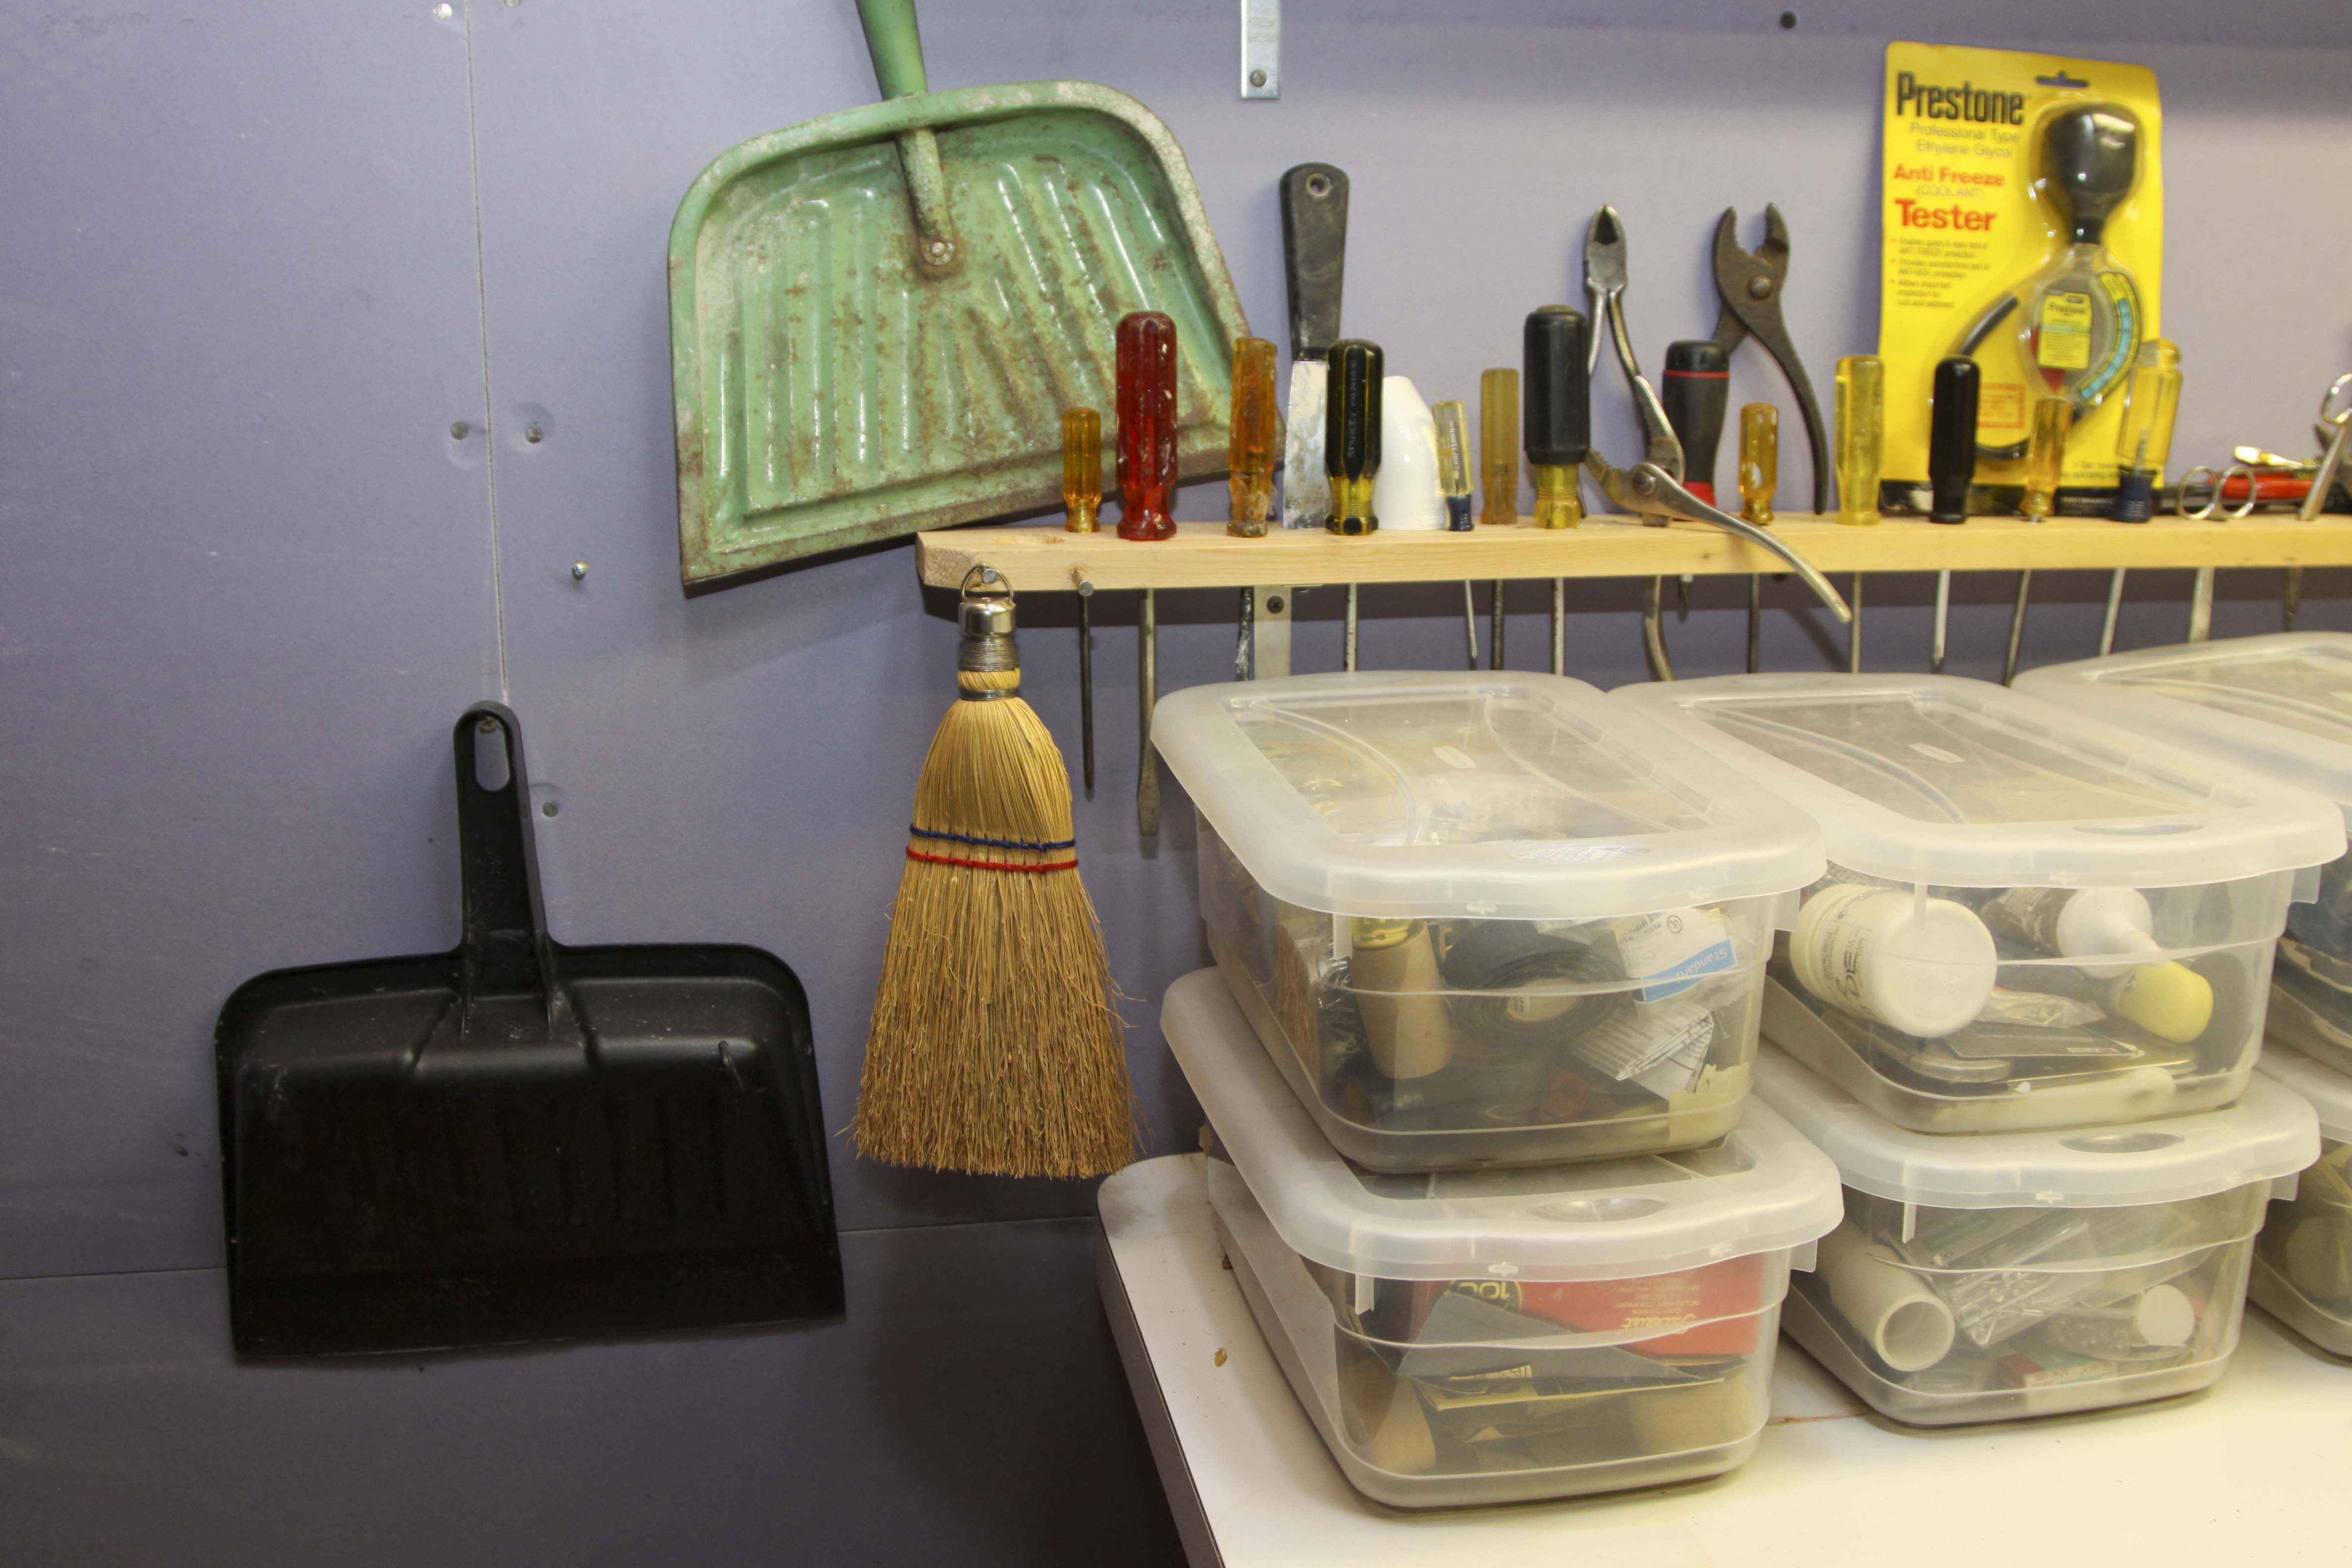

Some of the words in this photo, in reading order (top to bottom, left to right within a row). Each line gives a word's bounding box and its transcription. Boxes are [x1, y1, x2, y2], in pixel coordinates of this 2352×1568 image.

[1896, 71, 2024, 125] Prestone
[1910, 122, 1986, 139] Professional
[1990, 128, 2020, 144] Type
[1917, 139, 1969, 154] Ethylene
[1975, 144, 2012, 158] Glycol
[1894, 164, 1933, 181] Anti
[1939, 167, 2005, 186] Freeze
[1917, 184, 1985, 200] (COOLANT)
[1895, 198, 1997, 231] Tester
[1449, 428, 1460, 470] CRAFTSMAN
